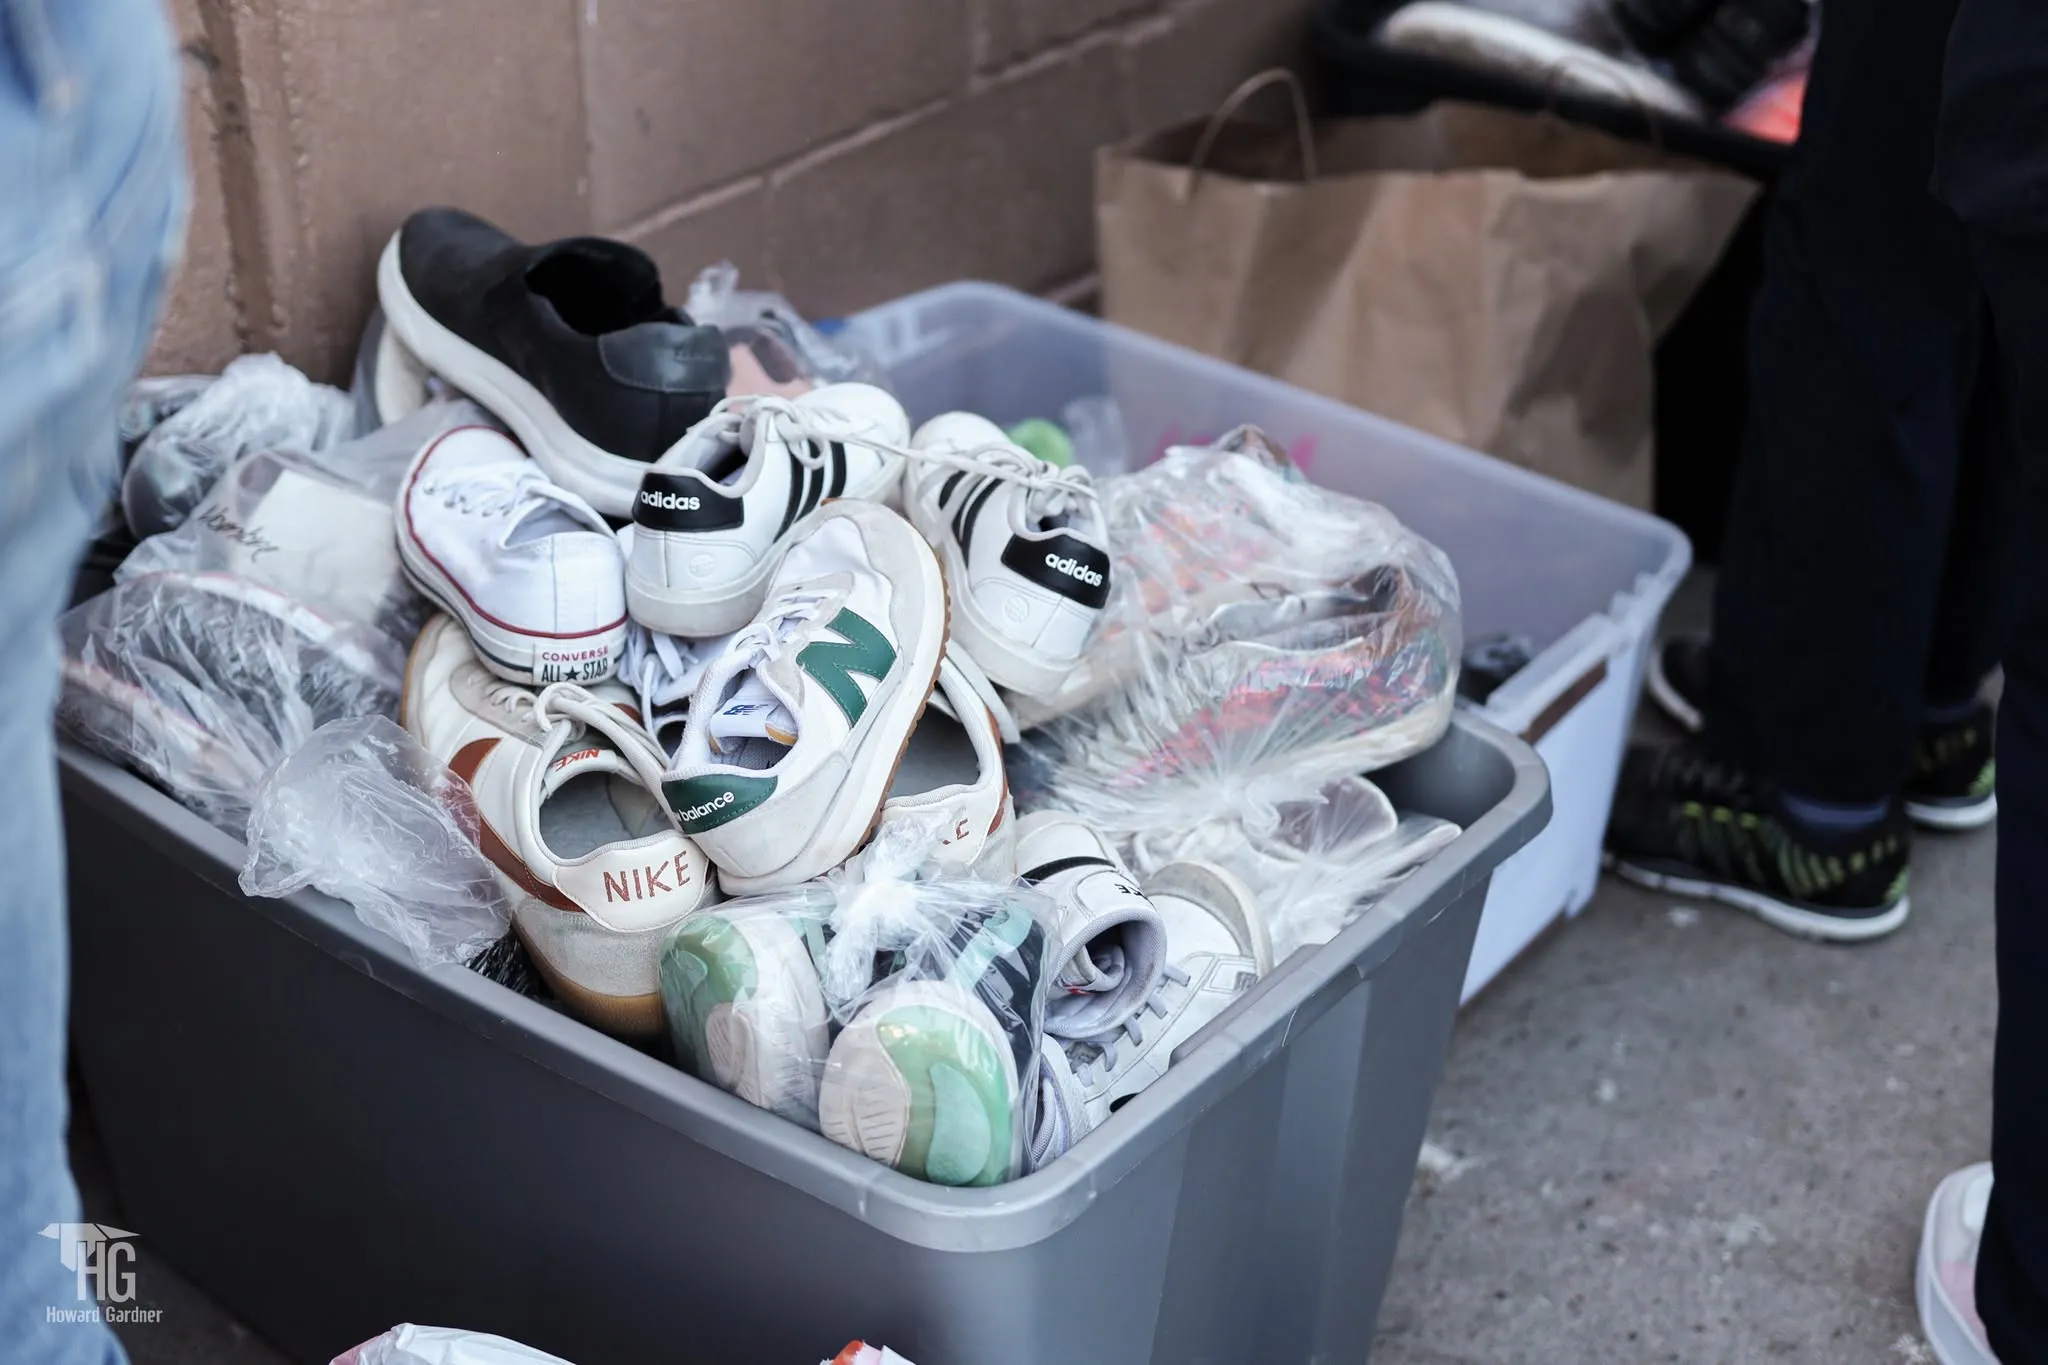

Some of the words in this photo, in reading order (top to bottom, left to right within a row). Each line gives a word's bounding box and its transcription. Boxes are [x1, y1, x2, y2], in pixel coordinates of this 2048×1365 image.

[640, 490, 701, 511] adidas
[1045, 553, 1103, 587] adidas
[542, 644, 609, 662] CONVERSE
[795, 606, 897, 731] N
[541, 663, 562, 683] ALL
[582, 657, 608, 681] STAR
[679, 791, 735, 822] balance
[603, 850, 691, 903] NIKE
